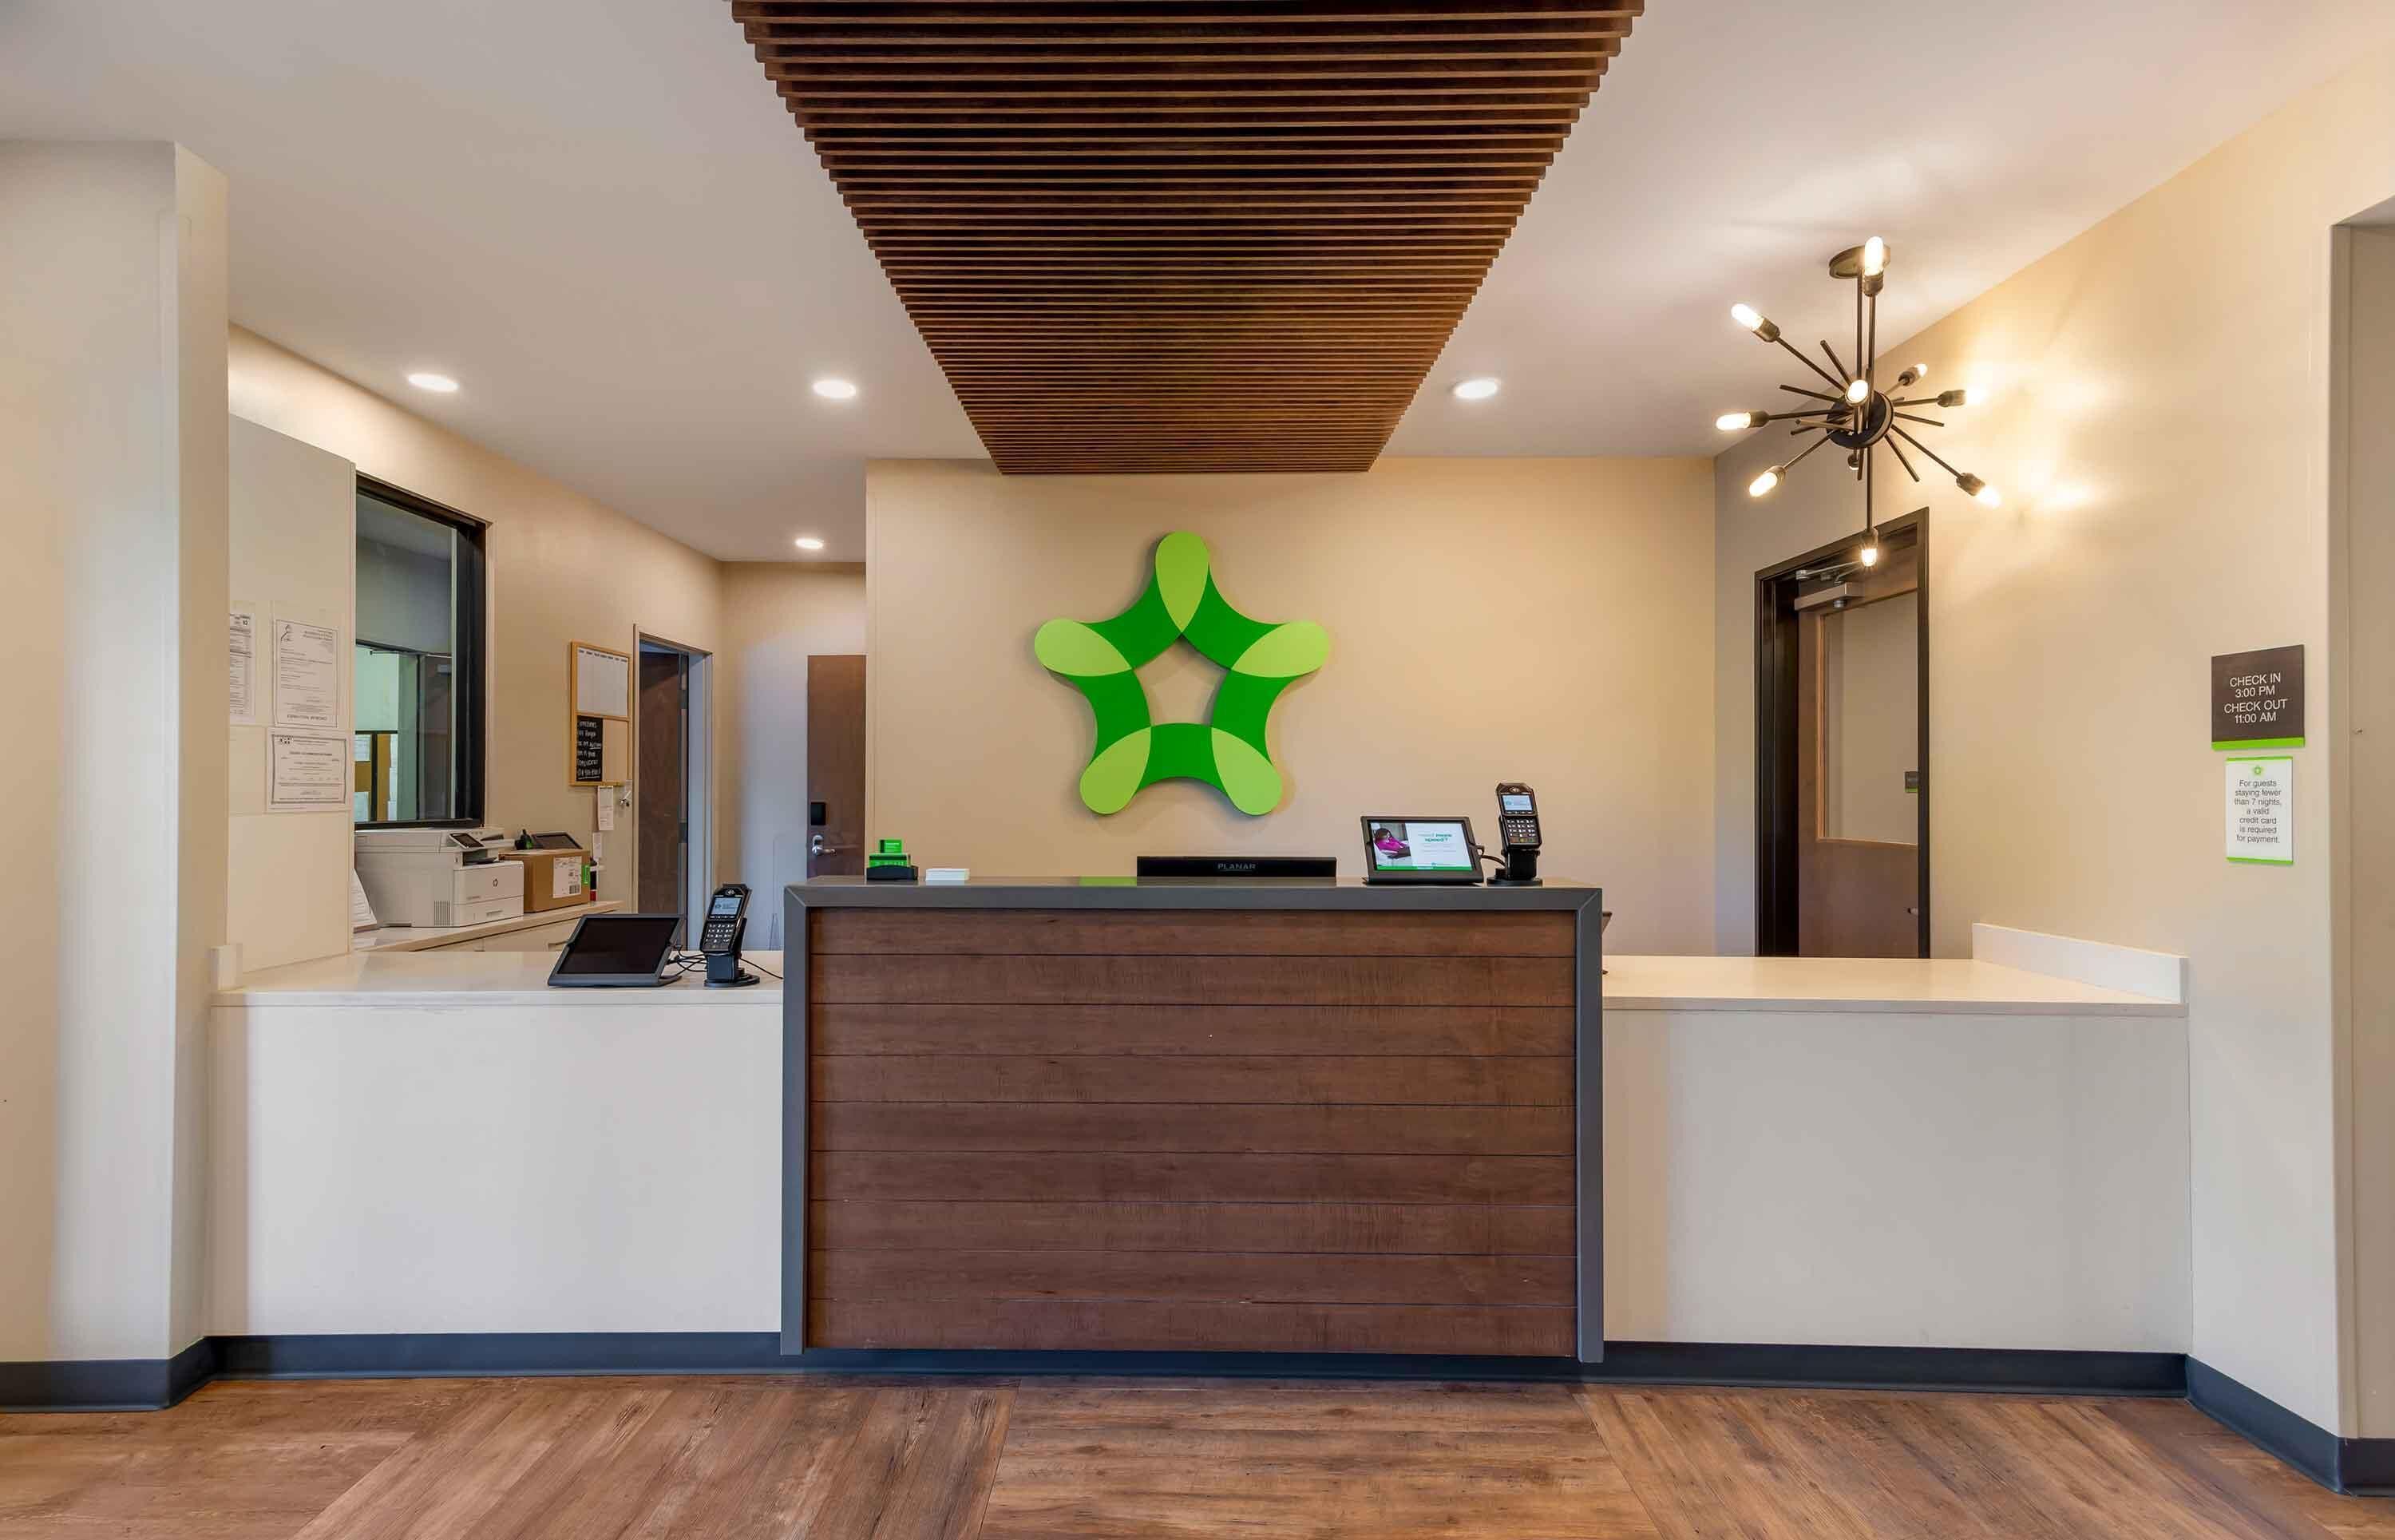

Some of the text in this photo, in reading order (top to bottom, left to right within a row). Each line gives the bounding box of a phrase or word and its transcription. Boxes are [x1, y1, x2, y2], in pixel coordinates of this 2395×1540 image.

[2230, 673, 2282, 687] CHECK IN
[2235, 686, 2275, 698] 3:00 PM
[2224, 699, 2288, 714] CHECK OUT
[2235, 712, 2277, 724] 11:00 AM
[2258, 798, 2282, 807] nights,
[2247, 825, 2277, 834] required
